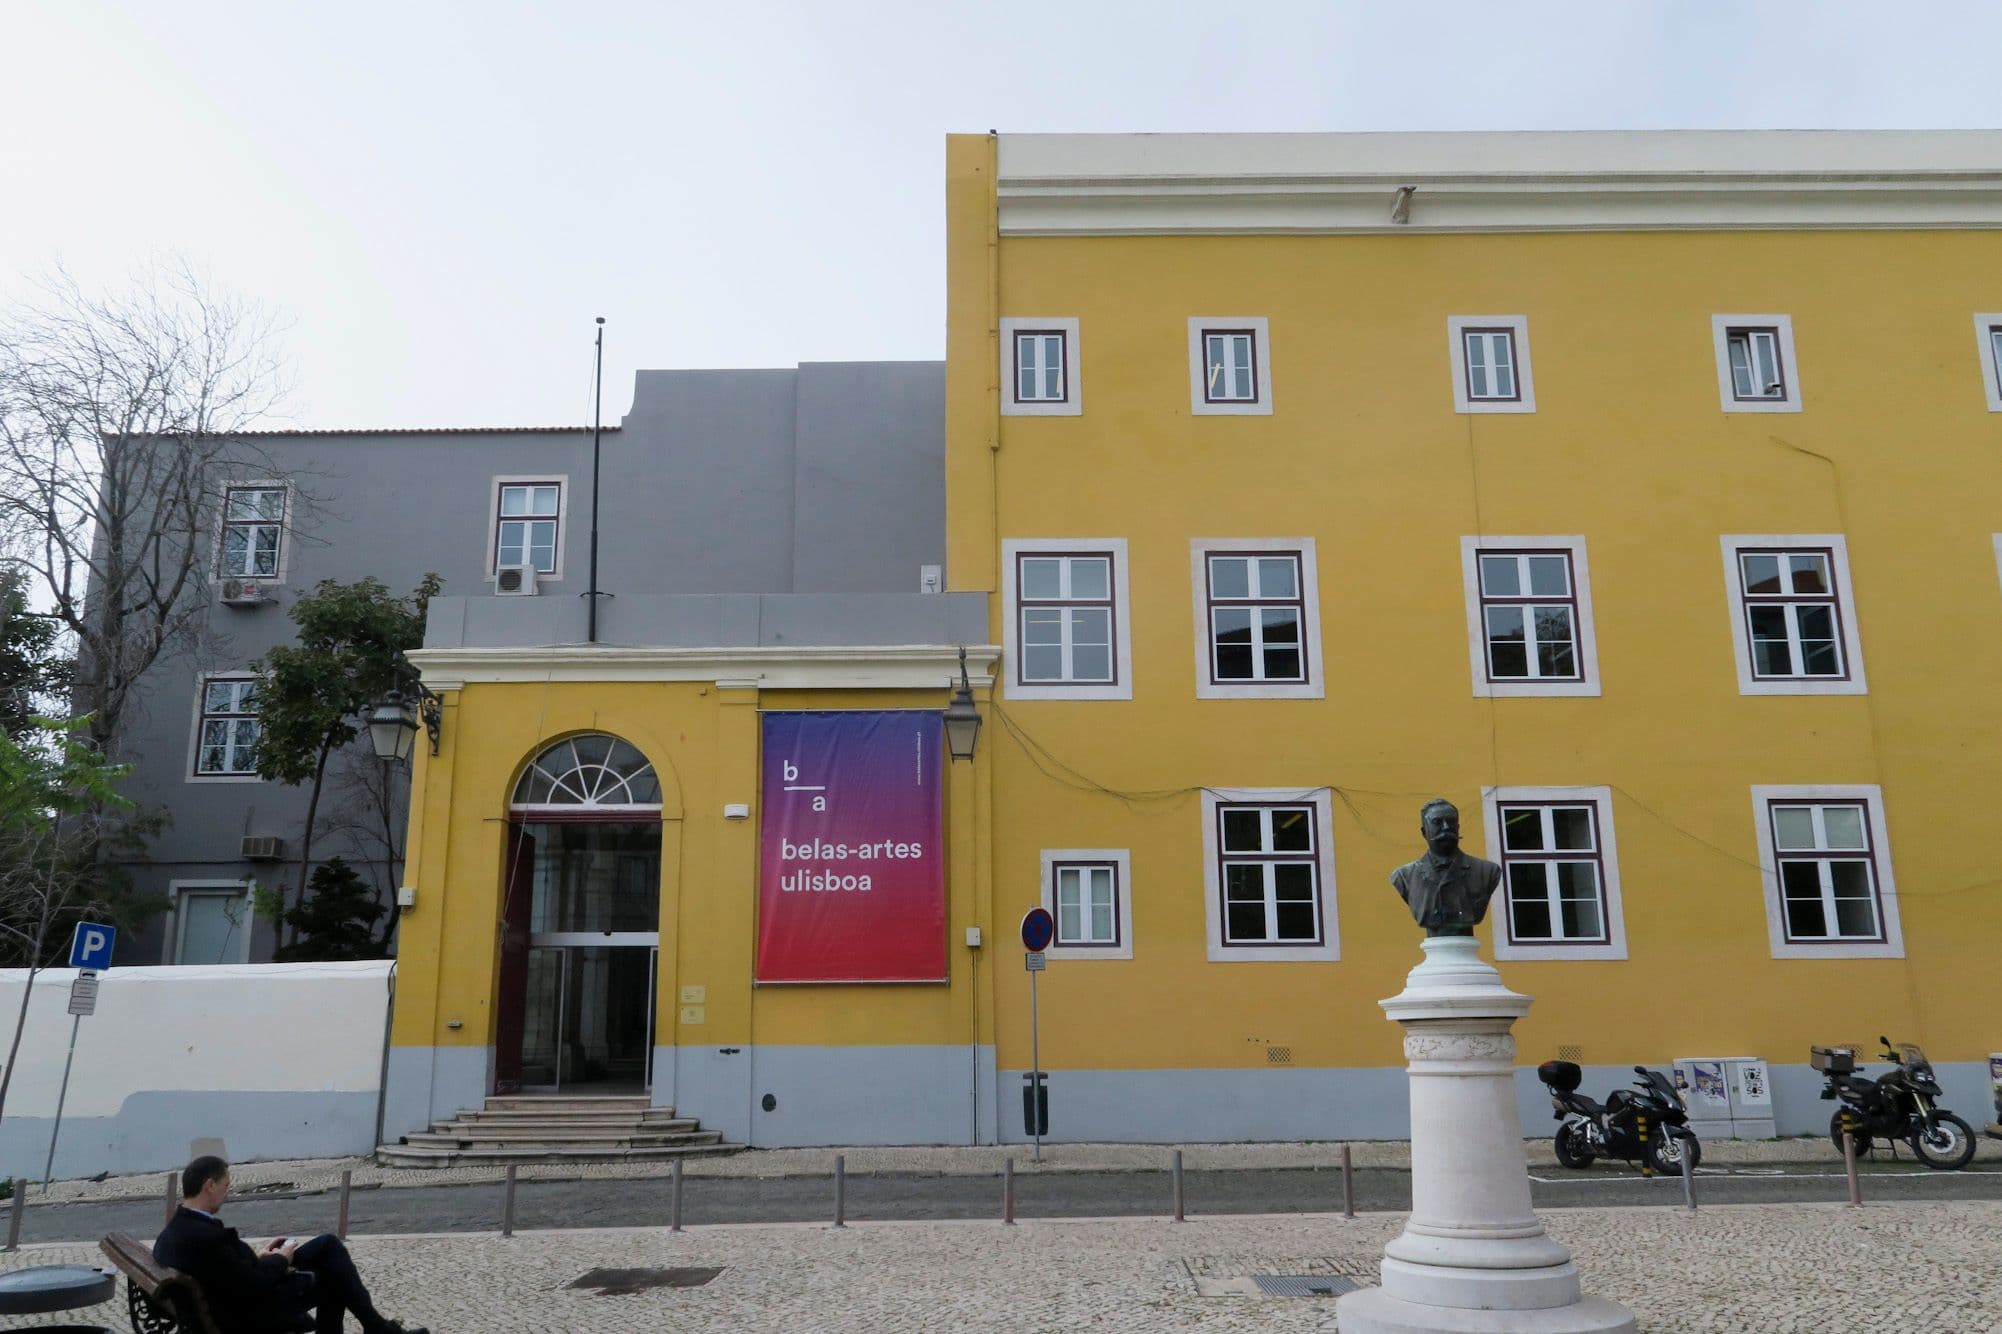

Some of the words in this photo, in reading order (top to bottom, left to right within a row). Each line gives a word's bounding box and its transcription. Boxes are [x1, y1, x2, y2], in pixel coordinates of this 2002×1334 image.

[783, 760, 799, 782] b
[812, 796, 826, 812] a
[781, 838, 922, 860] belas-artes
[781, 869, 872, 892] ulisboa
[82, 931, 105, 961] P
